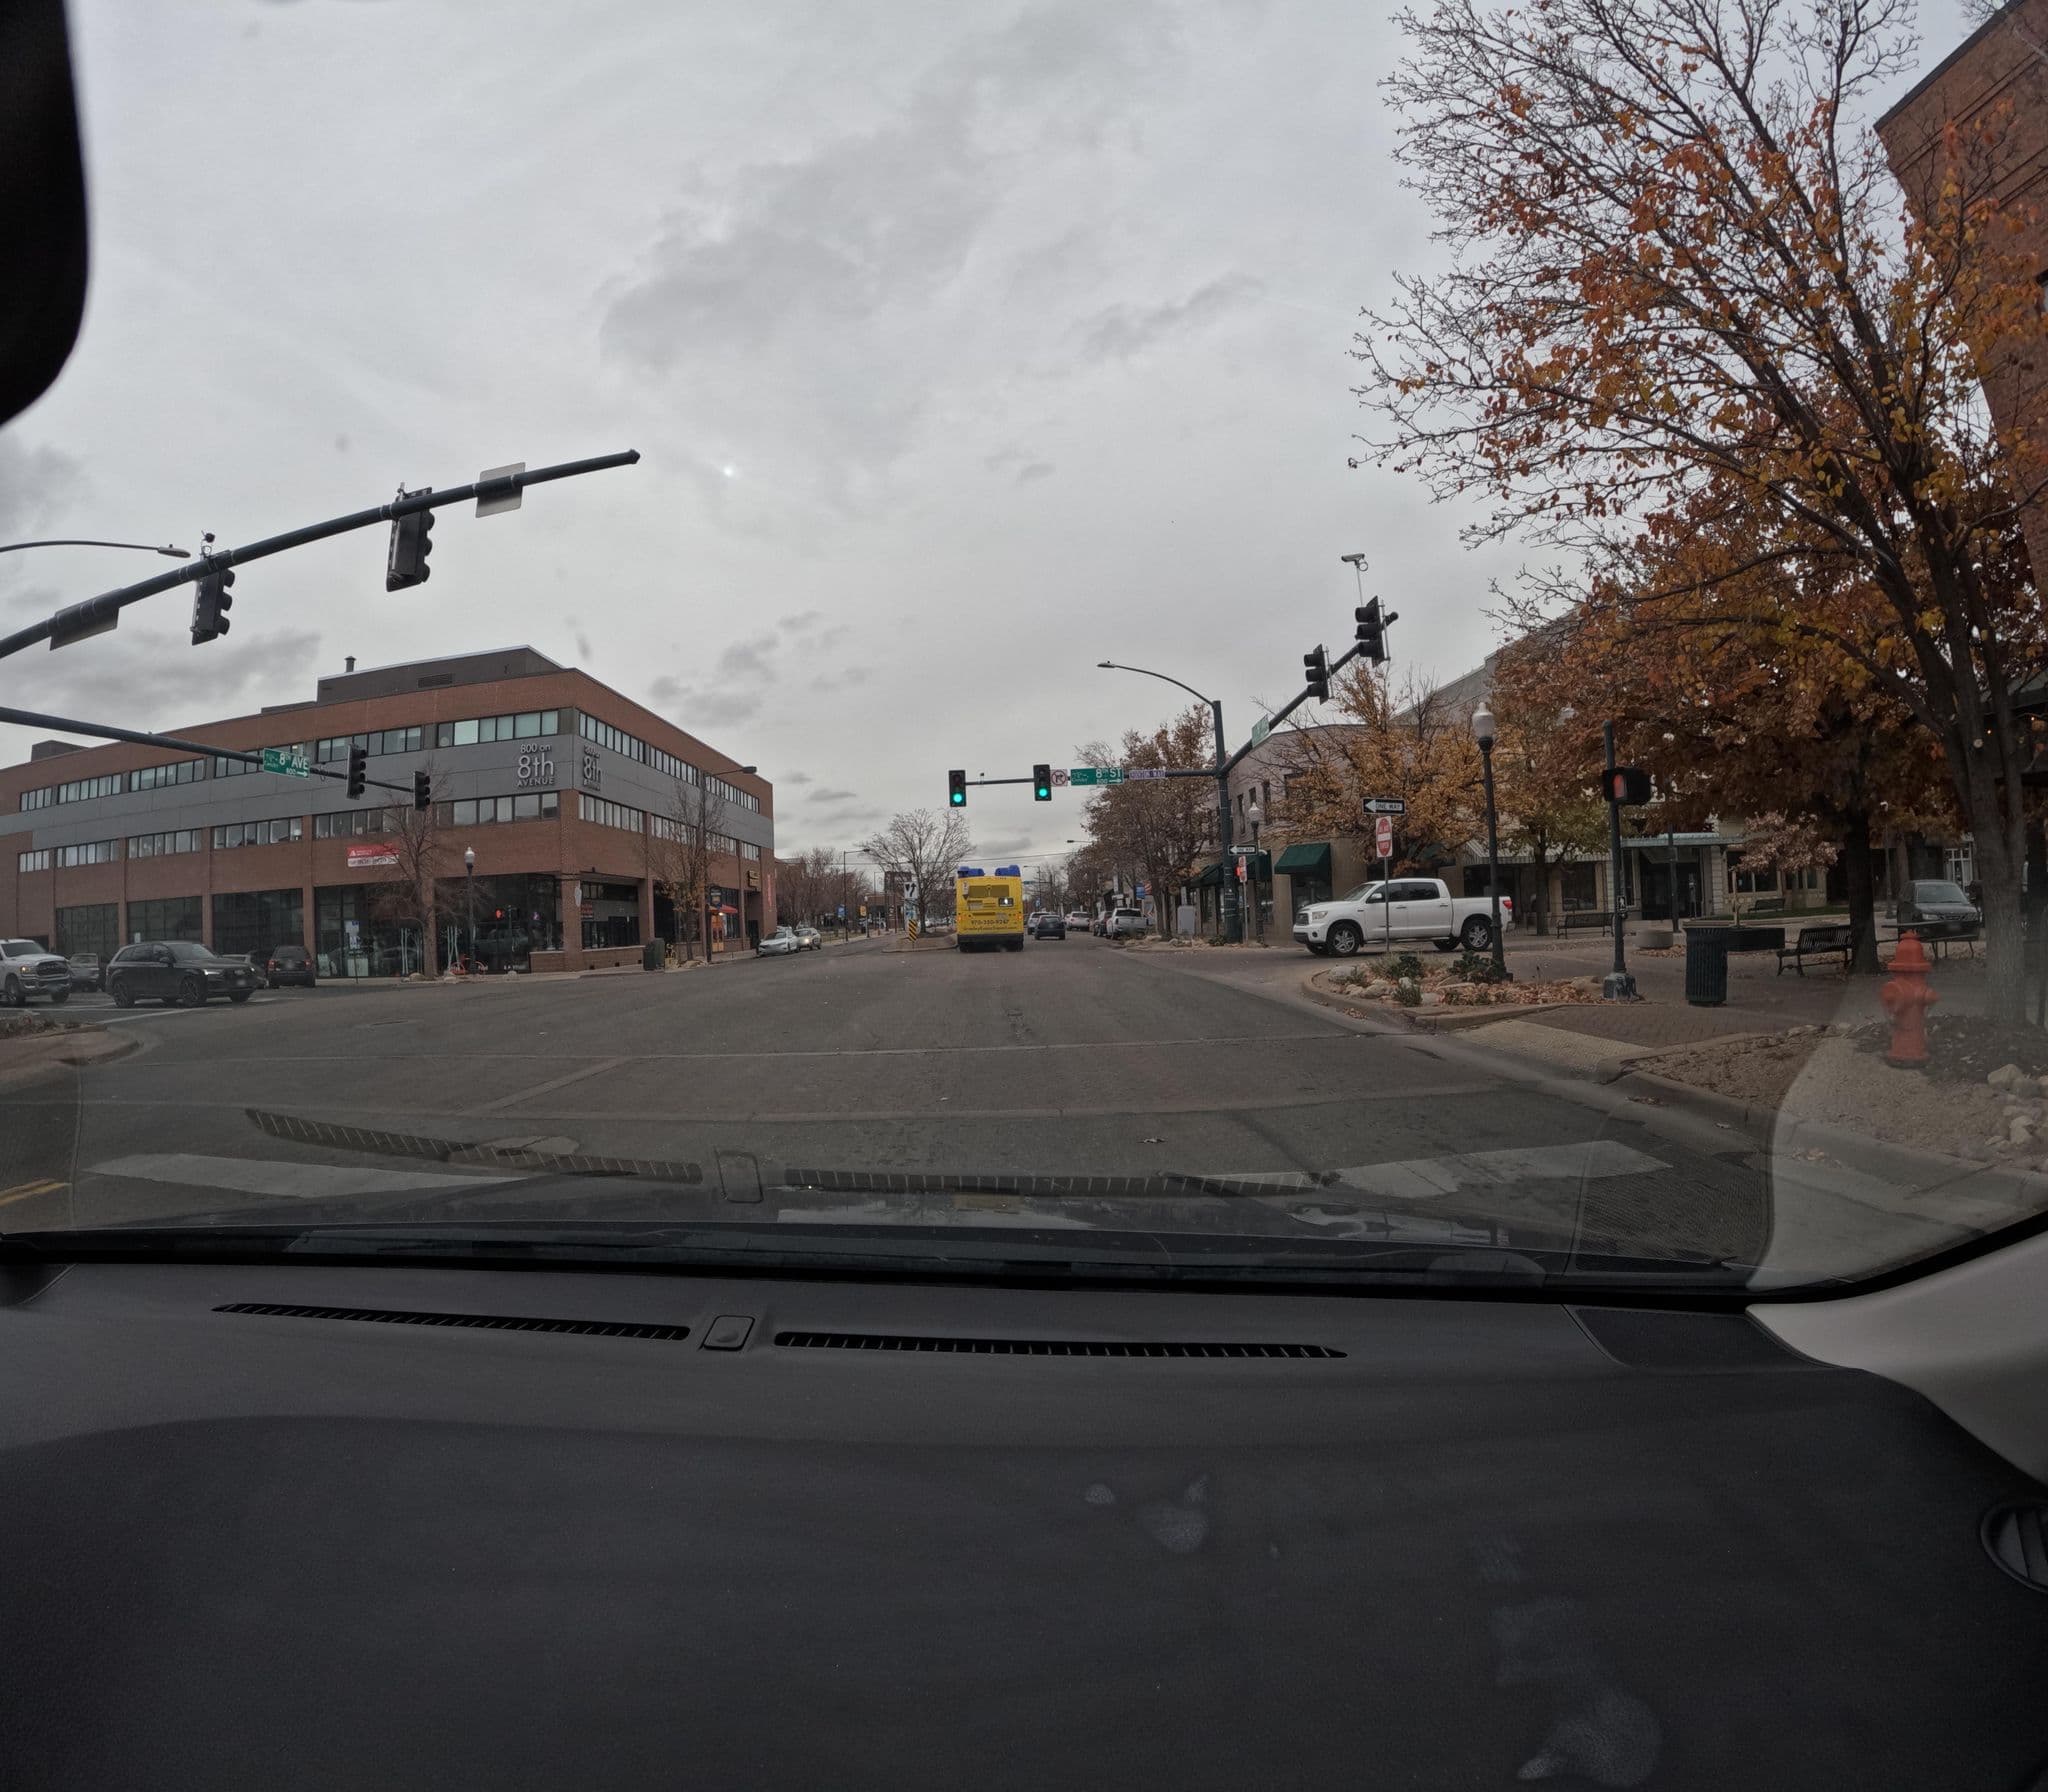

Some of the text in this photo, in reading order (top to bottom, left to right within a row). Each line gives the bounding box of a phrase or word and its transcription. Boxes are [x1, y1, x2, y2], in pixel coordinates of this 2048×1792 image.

[520, 744, 550, 753] 800 on
[291, 755, 309, 770] AVE
[518, 752, 554, 779] 8th
[1109, 767, 1122, 778] ST
[517, 778, 554, 787] AVENUE
